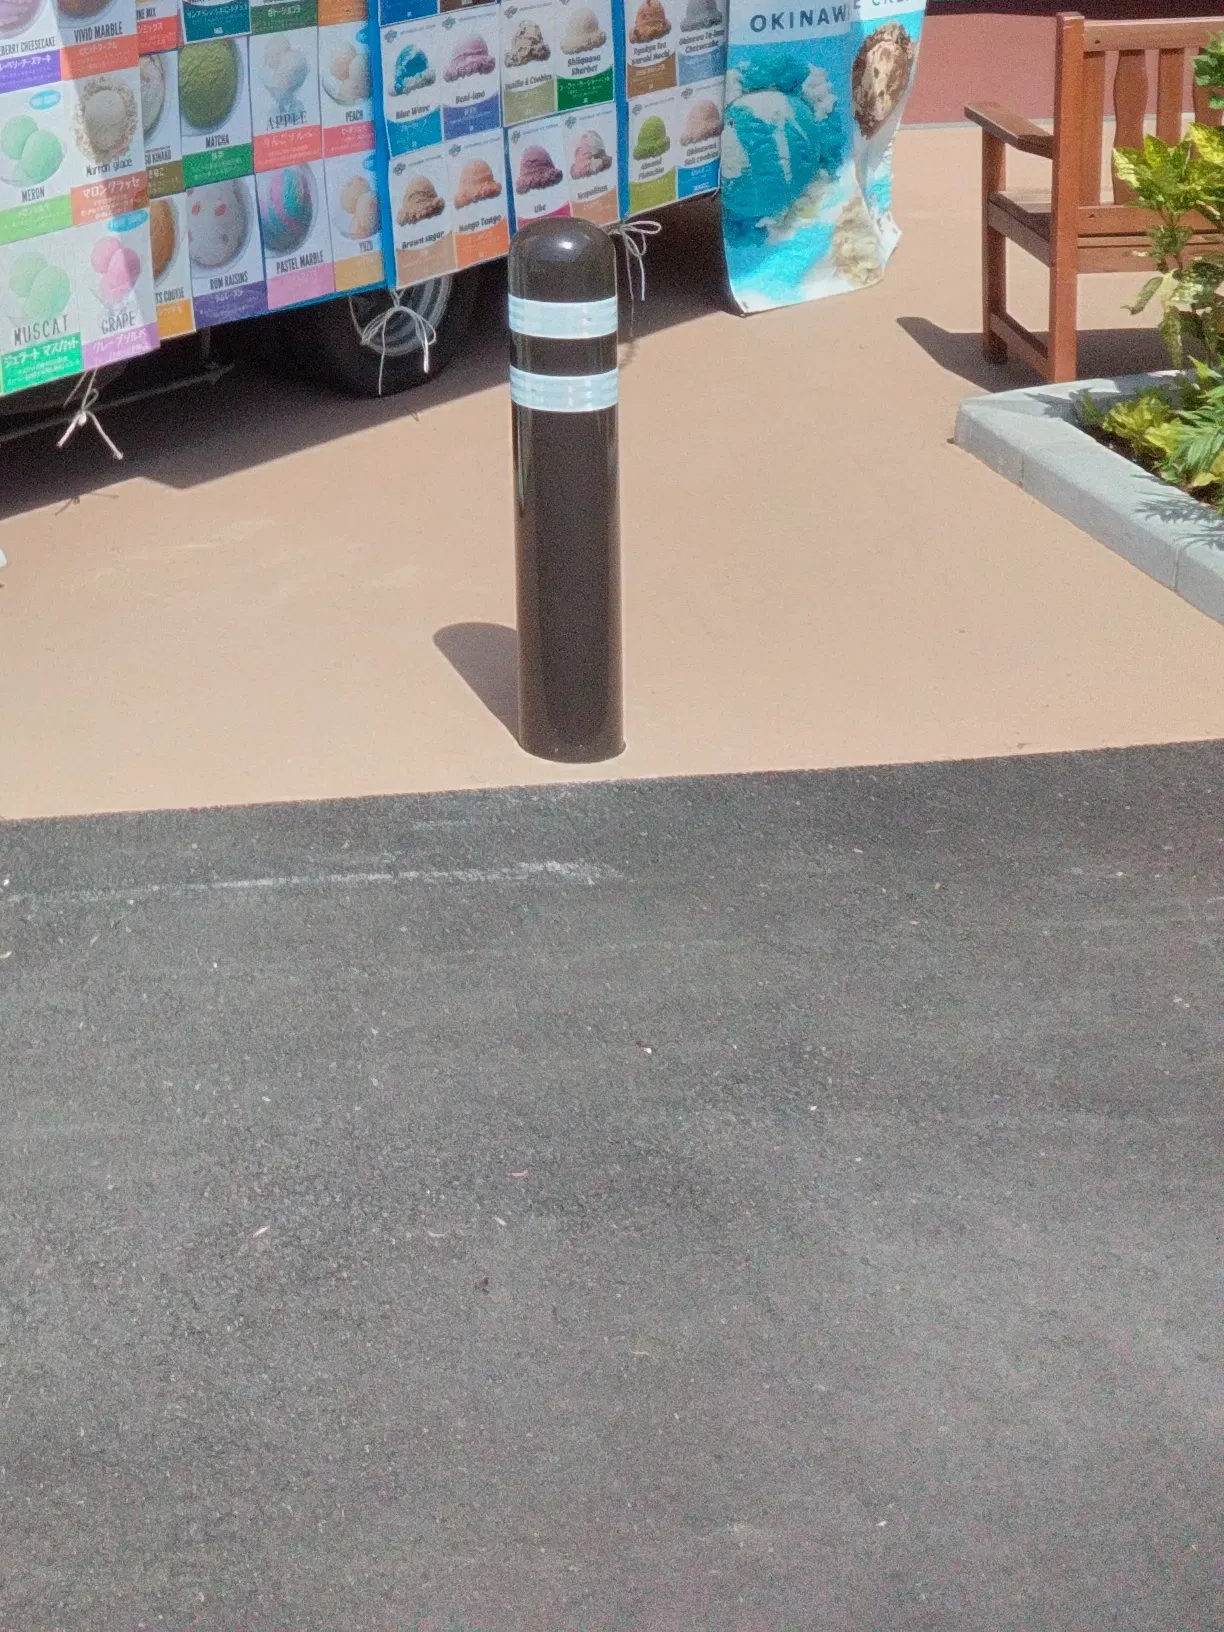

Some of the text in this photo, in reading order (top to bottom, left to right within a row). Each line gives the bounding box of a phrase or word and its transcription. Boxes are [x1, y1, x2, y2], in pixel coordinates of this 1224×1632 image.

[750, 3, 848, 33] OKINAW
[74, 21, 123, 44] VIVID MARBLE
[20, 36, 56, 53] CHEESECAKE
[266, 110, 308, 132] APPLE
[345, 109, 364, 123] PEACH
[205, 133, 230, 149] MATCHA
[21, 186, 46, 204] MERON
[82, 176, 141, 199] マロングラッセ
[401, 235, 425, 251] Brown
[276, 250, 324, 274] PASTEL MARBLE
[209, 270, 249, 290] RUM RAISINS
[13, 314, 68, 346] MUSCAT
[101, 310, 137, 335] GRAPE
